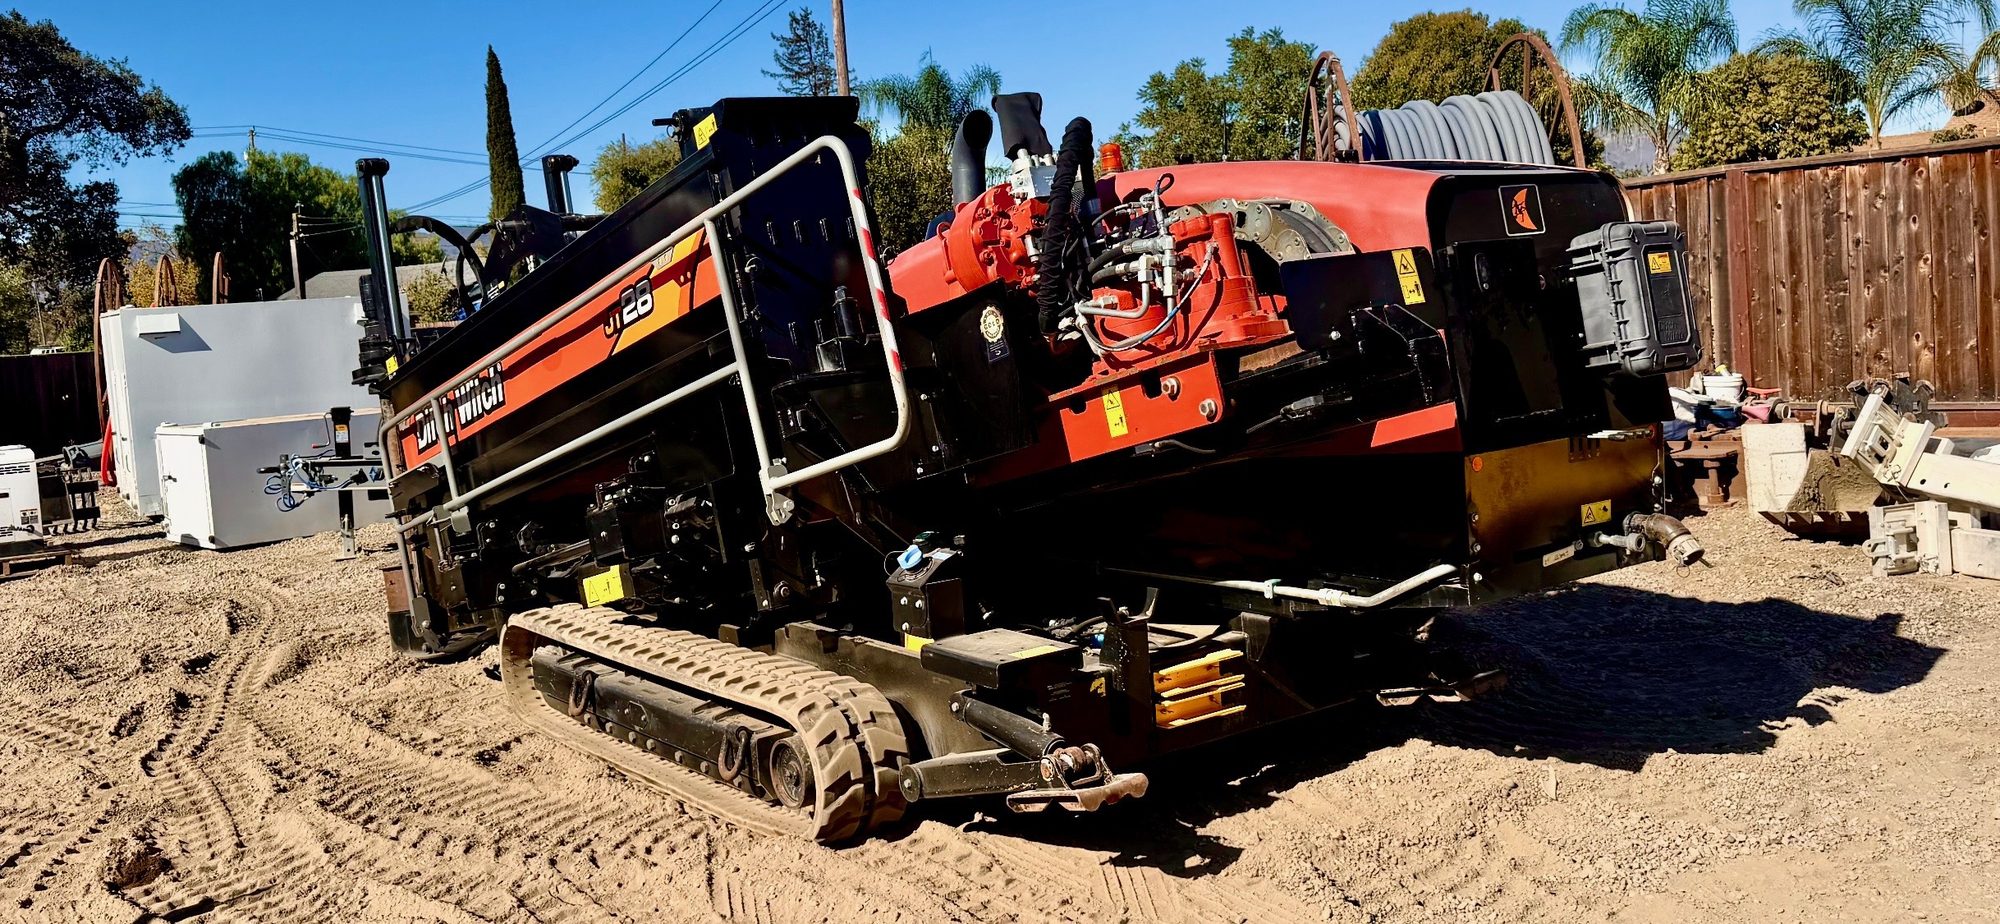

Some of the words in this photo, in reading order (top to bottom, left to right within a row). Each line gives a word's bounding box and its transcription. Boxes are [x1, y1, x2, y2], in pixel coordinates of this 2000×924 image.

[604, 280, 653, 335] JT28
[415, 397, 454, 450] Dith
[454, 366, 503, 425] Witch
